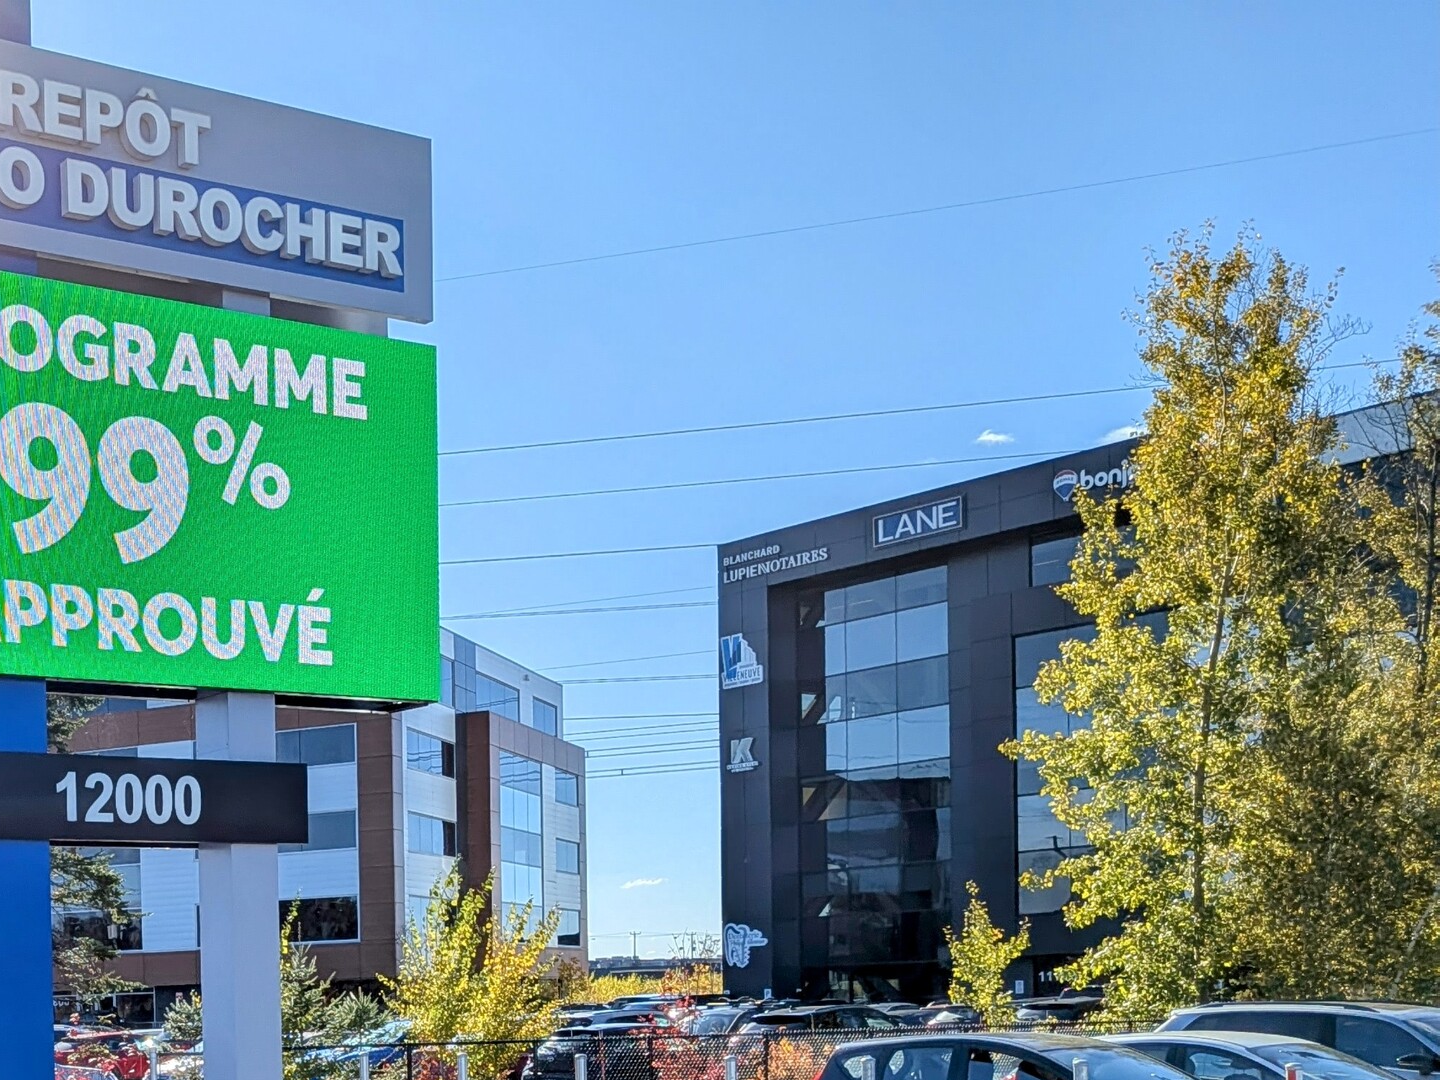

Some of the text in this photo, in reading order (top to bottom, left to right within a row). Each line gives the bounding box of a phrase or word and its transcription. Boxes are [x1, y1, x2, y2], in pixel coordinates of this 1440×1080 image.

[61, 157, 404, 278] DUROCHER
[1080, 459, 1134, 490] bonj
[877, 500, 958, 544] LANE
[723, 545, 780, 566] BLANCHARD
[55, 771, 202, 825] 12000
